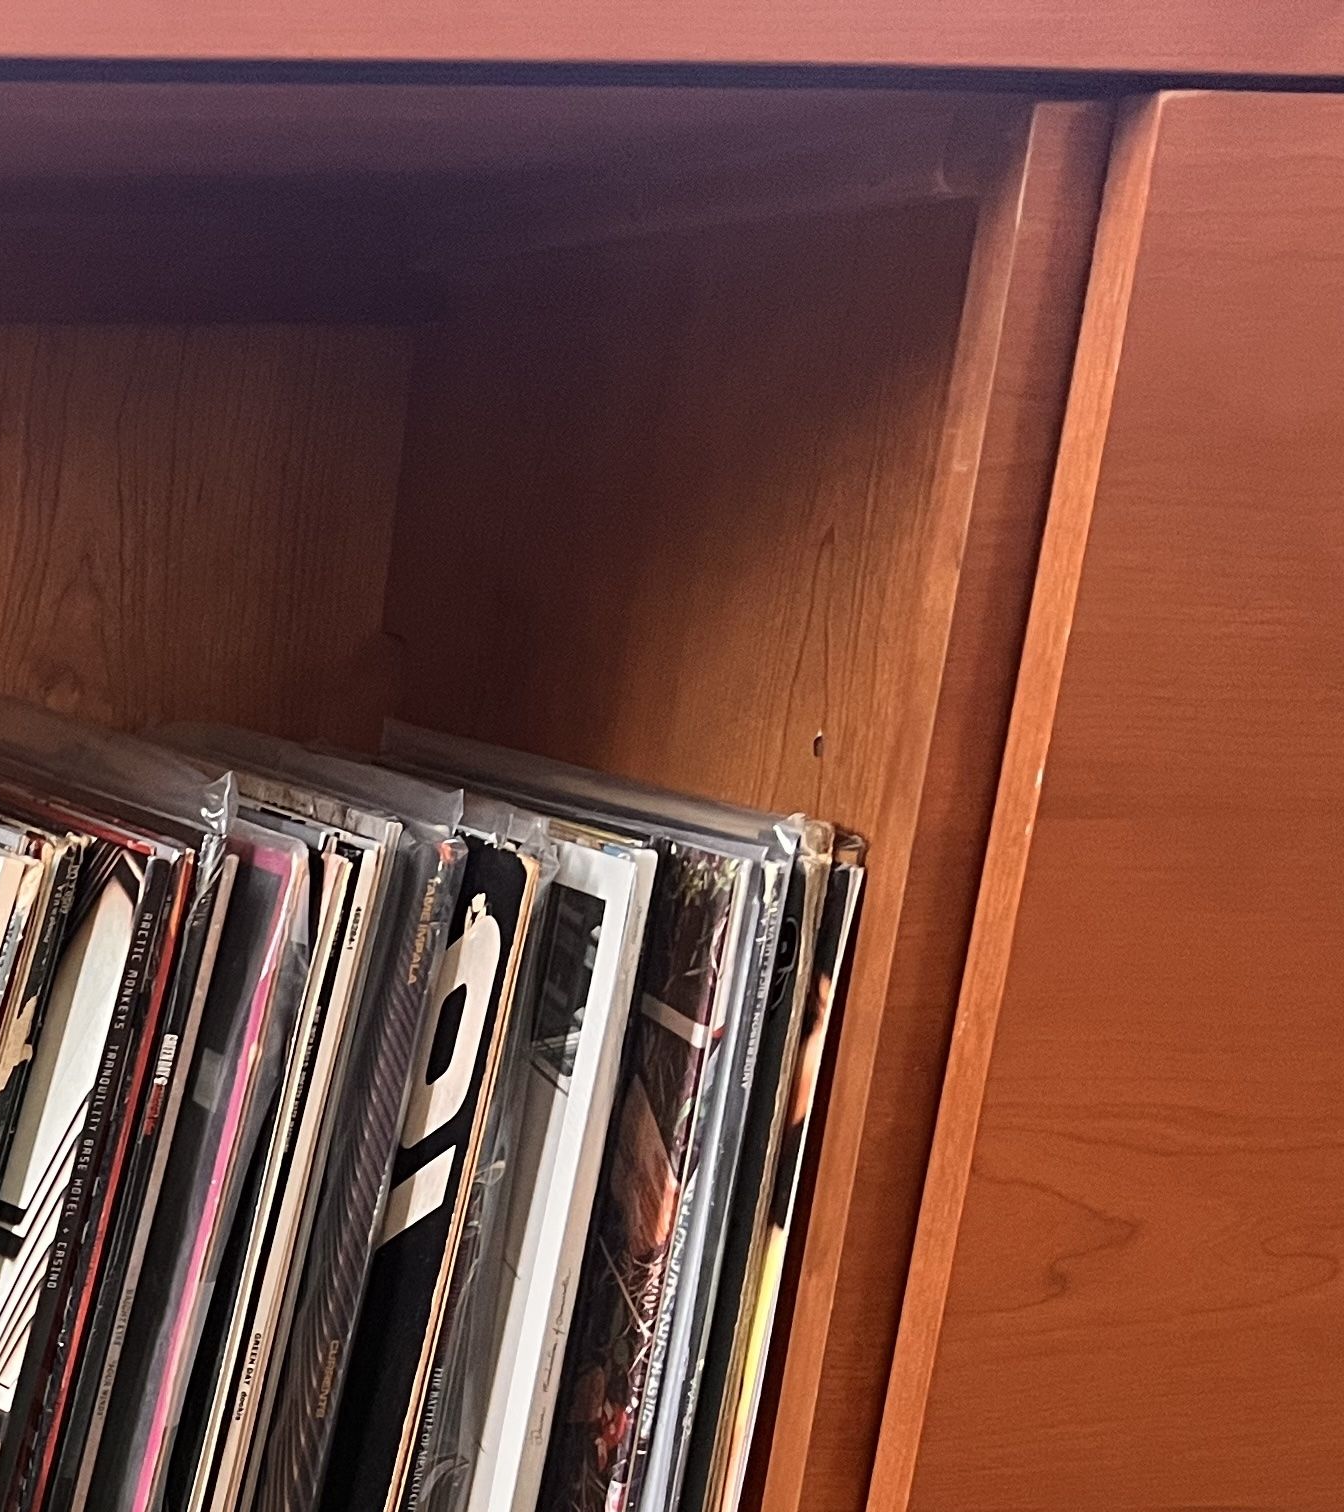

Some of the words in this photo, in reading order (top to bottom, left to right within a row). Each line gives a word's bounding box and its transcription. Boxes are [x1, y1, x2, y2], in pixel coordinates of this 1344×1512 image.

[419, 877, 438, 923] TAME
[130, 910, 153, 963] ARCTIC
[406, 923, 428, 986] IMPALA
[113, 967, 138, 1030] MONKEYS
[86, 1042, 119, 1132] TRANQUILITY
[76, 1136, 94, 1171] BASE
[64, 1176, 84, 1219] HOTEL
[45, 1239, 67, 1290] CASINO
[248, 1332, 262, 1366] GREEN
[243, 1366, 254, 1385] DAY
[314, 1337, 341, 1419] CURRENTS
[430, 1366, 444, 1389] THE
[234, 1390, 247, 1422] dookie
[422, 1390, 439, 1431] BATTLE
[419, 1431, 431, 1447] OF
[410, 1447, 428, 1494] MEXICO
